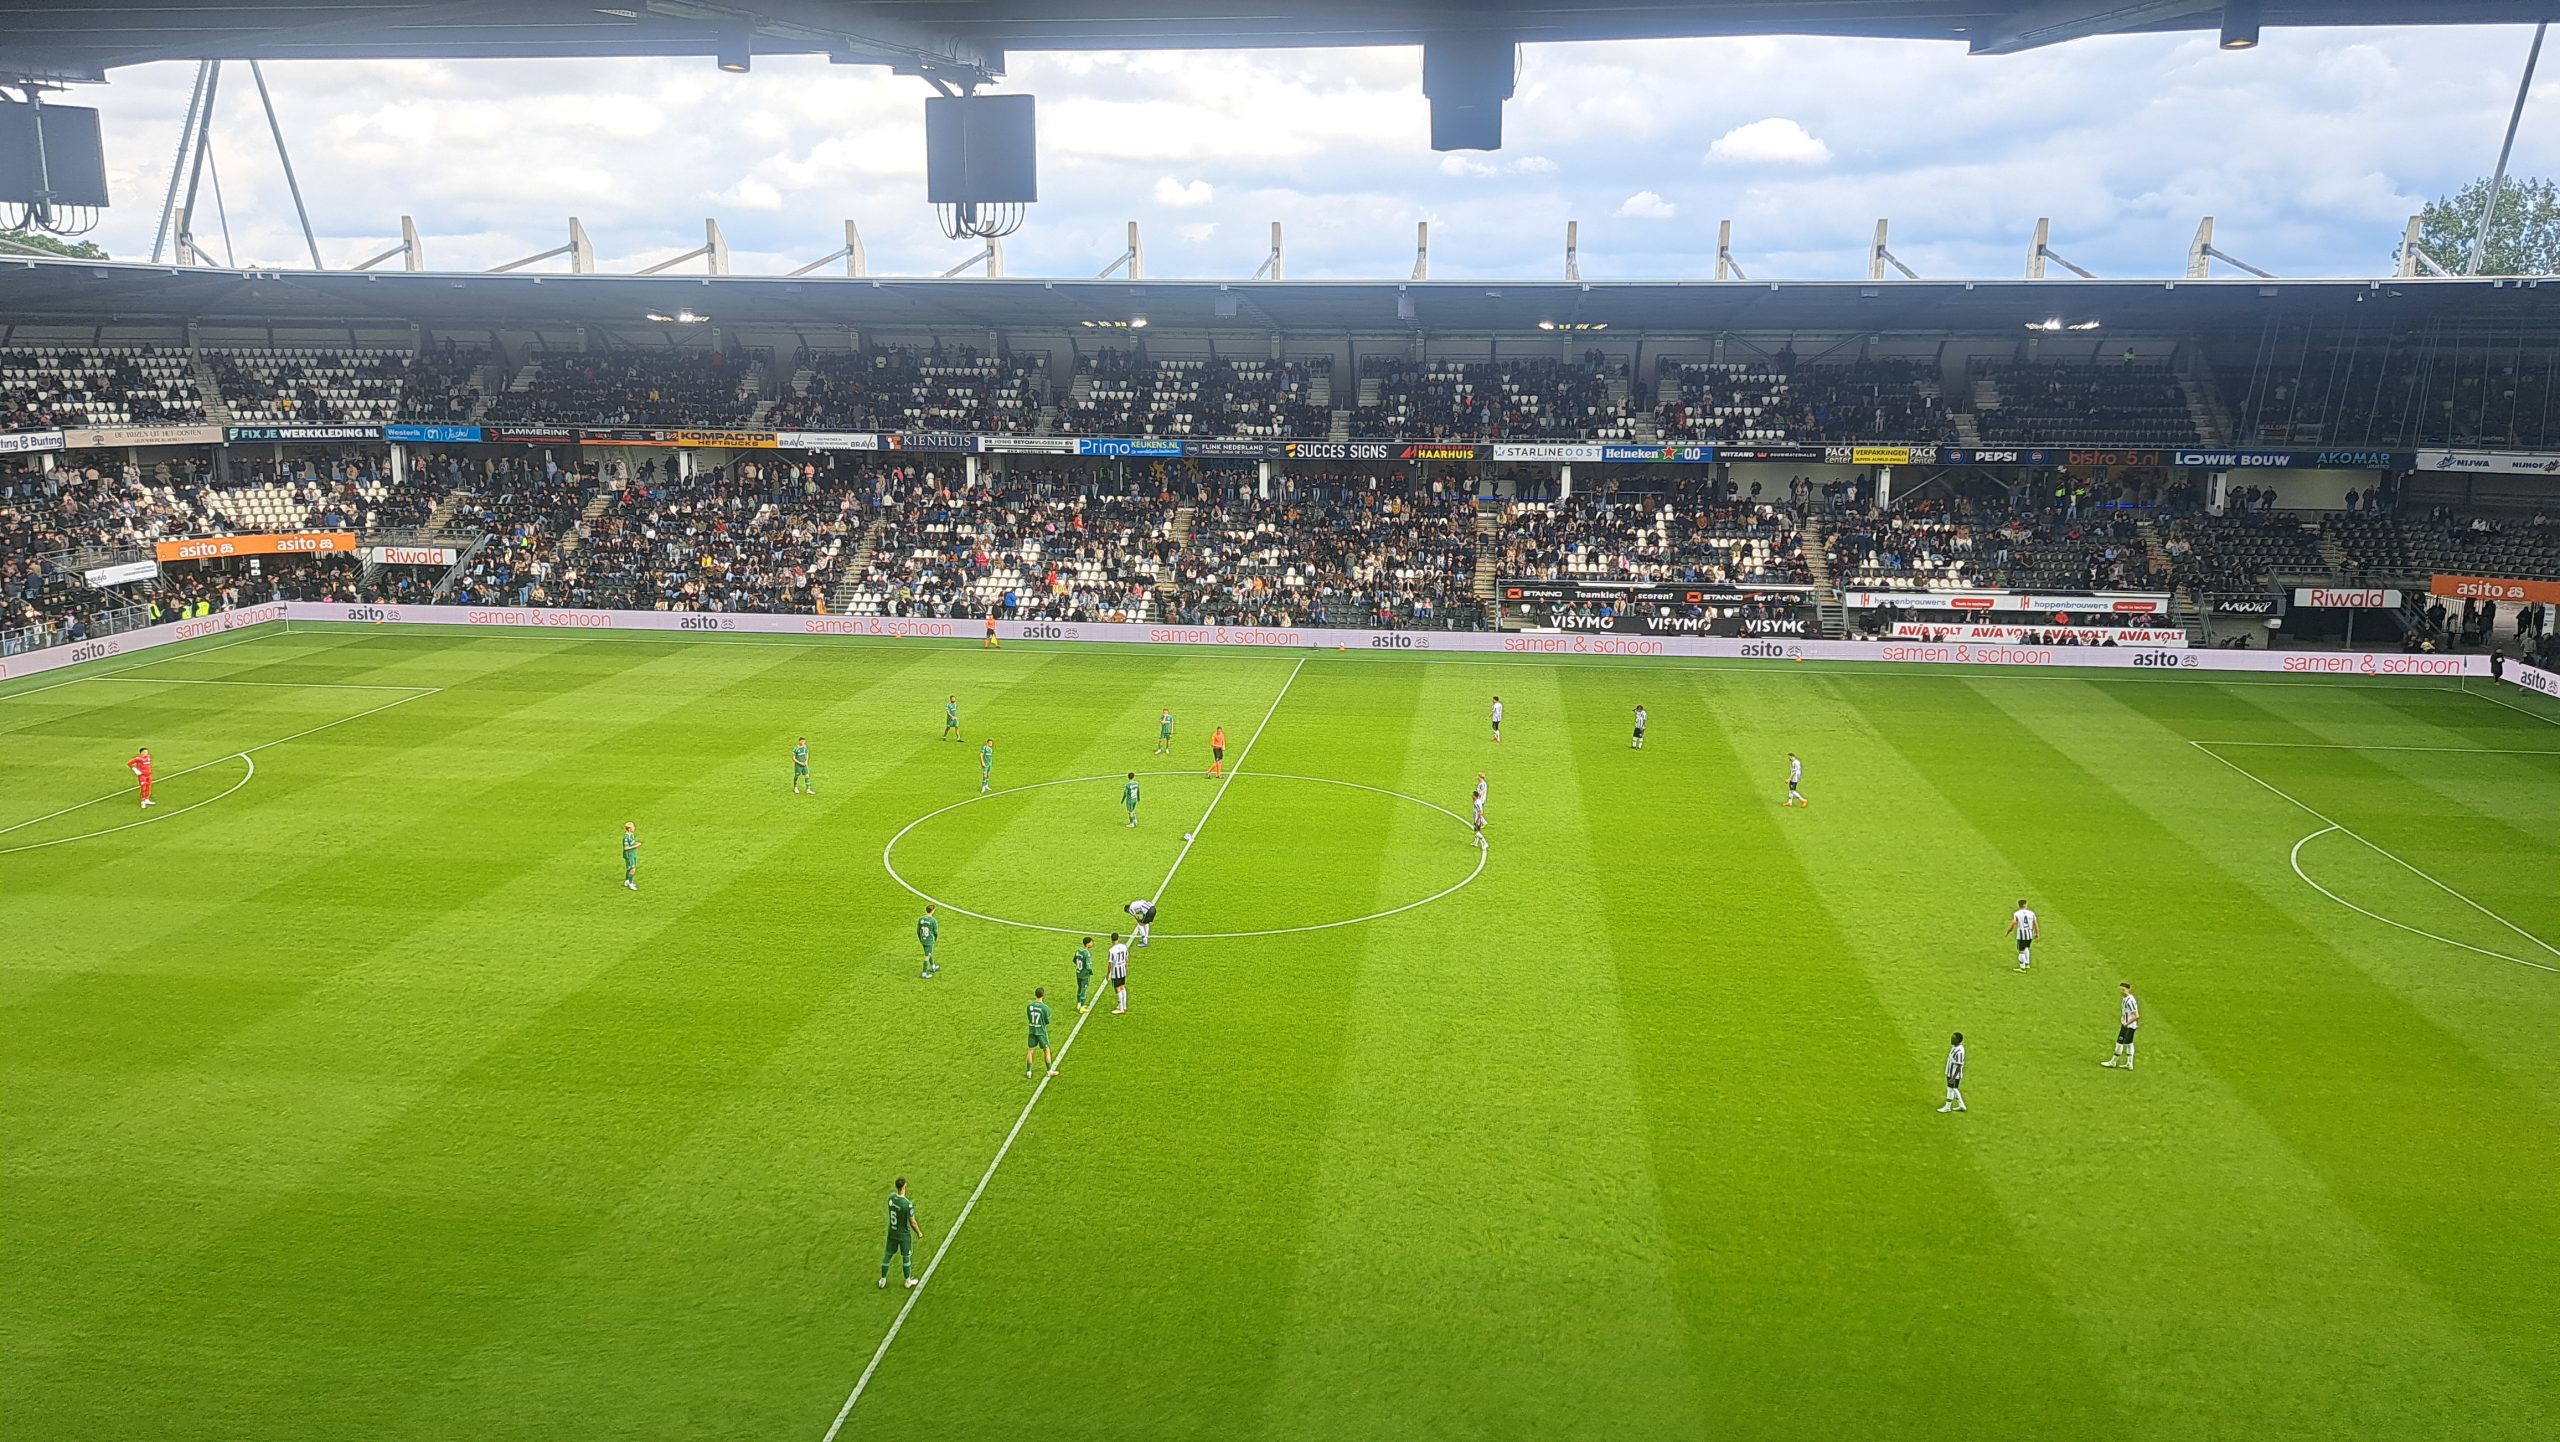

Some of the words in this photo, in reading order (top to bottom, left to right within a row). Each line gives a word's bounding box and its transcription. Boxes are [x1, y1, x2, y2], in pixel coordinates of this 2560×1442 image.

[241, 429, 261, 439] FIX
[264, 429, 277, 439] JE
[280, 428, 379, 439] WERKKLEDING.NL
[501, 428, 570, 436] LAMMERINK
[680, 432, 775, 441] KOMPACTOR
[780, 433, 804, 447] BRAVO
[850, 436, 876, 448] BRAVO
[903, 436, 971, 446] KIENHUIS
[1131, 441, 1180, 449] KEUKENS.NL
[1081, 440, 1130, 454] Primo
[1297, 444, 1346, 458] SUCCES
[1350, 444, 1387, 458] SIGNS
[1825, 448, 1852, 456] PACK
[1910, 448, 1936, 457] PACK
[1418, 450, 1474, 459] HAARHUIS
[1606, 448, 1659, 458] Heineken
[1683, 448, 1700, 460] 0.0
[1824, 456, 1852, 464] center
[1910, 456, 1936, 464] center
[1975, 451, 2018, 462] PEPSI
[2068, 450, 2116, 465] bistro
[2240, 454, 2290, 466] BOUW
[2316, 452, 2390, 464] AKOMAR
[2456, 460, 2490, 468] NIJWA
[179, 542, 218, 558] asito
[277, 538, 316, 551] asito
[386, 548, 444, 564] Riwald
[2457, 580, 2504, 597] asito
[1638, 592, 1674, 600] scoren?
[2310, 589, 2384, 607] Riwald
[2034, 600, 2108, 610] hoppenbrouwers
[348, 605, 384, 620] asito
[469, 610, 526, 624] samen
[531, 609, 544, 625] &
[550, 610, 612, 627] schoon
[176, 616, 218, 641] samen
[224, 612, 234, 628] &
[236, 607, 281, 626] schoon
[680, 615, 718, 630] asito
[806, 620, 864, 634] samen
[870, 618, 883, 634] &
[888, 619, 952, 636] schoon
[1550, 616, 1615, 629] VISYMO
[1022, 623, 1061, 638] asito
[1150, 628, 1210, 644] samen
[1216, 628, 1230, 644] &
[1234, 629, 1300, 645] schoon
[1933, 626, 1962, 638] VOLT
[2078, 630, 2108, 639] VOLT
[1372, 632, 1411, 648] asito
[2154, 632, 2184, 643] VOLT
[1504, 636, 1567, 652] samen
[1574, 636, 1588, 652] &
[1593, 636, 1663, 654] schoon
[1740, 641, 1783, 657] asito
[72, 642, 105, 662] asito
[1882, 646, 1948, 662] samen
[1956, 645, 1971, 662] &
[1976, 647, 2050, 664] schoon
[2133, 650, 2178, 667] asito
[2282, 656, 2353, 672] samen
[2360, 654, 2376, 672] &
[2383, 656, 2460, 674] schoon
[2520, 670, 2546, 690] asito
[1030, 1012, 1041, 1024] 17
